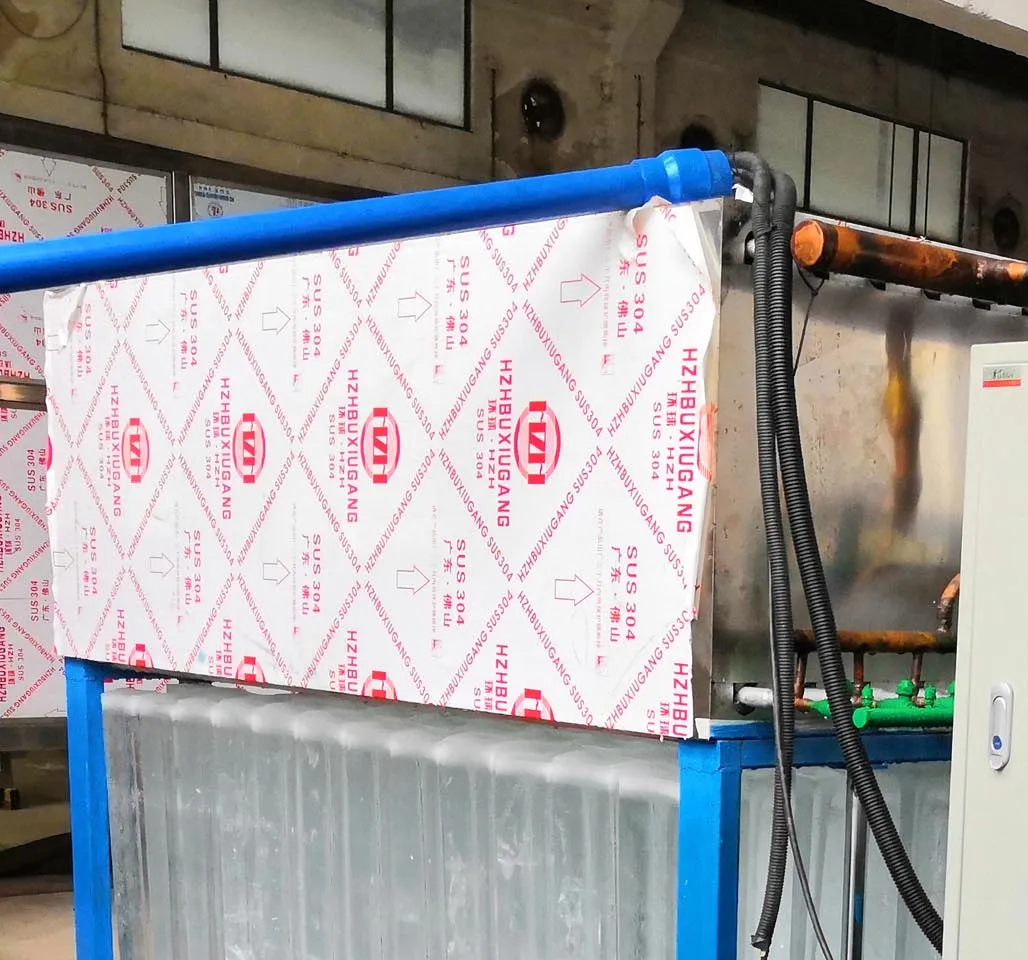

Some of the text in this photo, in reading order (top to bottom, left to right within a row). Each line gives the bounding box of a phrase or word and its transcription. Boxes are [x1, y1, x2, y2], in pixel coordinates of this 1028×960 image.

[210, 280, 232, 321] SUS304
[340, 265, 362, 307] SUS304
[459, 255, 469, 346] SUS 304
[491, 248, 518, 293] SUS304
[633, 234, 648, 333] SUS 304
[178, 329, 233, 446] HZHBUXIUGANG SUS304
[235, 328, 296, 444] HZHBUXIUGANG SUS304
[298, 318, 362, 443] HZHBUXIUGANG SUS304
[365, 316, 435, 440] HZHBUXIUGANG SUS304
[438, 301, 518, 440] HZHBUXIUGANG SUS304
[523, 300, 604, 437] HZHBUXIUGANG SUS304
[607, 284, 706, 438] HZHBUXIUGANG SUS304
[111, 385, 122, 517] HZHBUXIUGANG
[220, 378, 232, 520] HZHBUXIUGANG
[348, 369, 358, 523] HZHBUXIUGANG
[476, 408, 484, 443] SUS
[498, 360, 512, 527] HZHBUXIUGANG
[651, 402, 661, 480] SUS 304
[677, 348, 698, 533] HZHBUXIUGANG
[127, 454, 176, 560] HZHBUXIUGANG SUS304
[178, 454, 234, 566] HZHBUXIUGANG SUS304
[237, 453, 295, 566] HZHBUXIUGANG SUS304
[298, 453, 361, 573] HZHBUXIUGANG SUS304
[365, 448, 436, 573] HZHBUXIUGANG SUS304
[438, 448, 513, 582] HZHBUXIUGANG SUS304
[517, 448, 602, 582] HZHBUXIUGANG SUS304
[607, 448, 665, 544] HZHBUXIUGANG
[193, 530, 201, 603] SUS 304
[216, 573, 235, 609] SUS304
[236, 574, 276, 650] HZHBUXIUGANG
[313, 534, 321, 614] SUS 304
[338, 581, 361, 620] SUS304
[456, 538, 465, 626] SUS 304
[486, 590, 513, 633] SUS304
[625, 545, 638, 640] SUS 304
[365, 581, 410, 668] HZHBUXIUGANG
[517, 591, 571, 692] HZHBUXIUGANG
